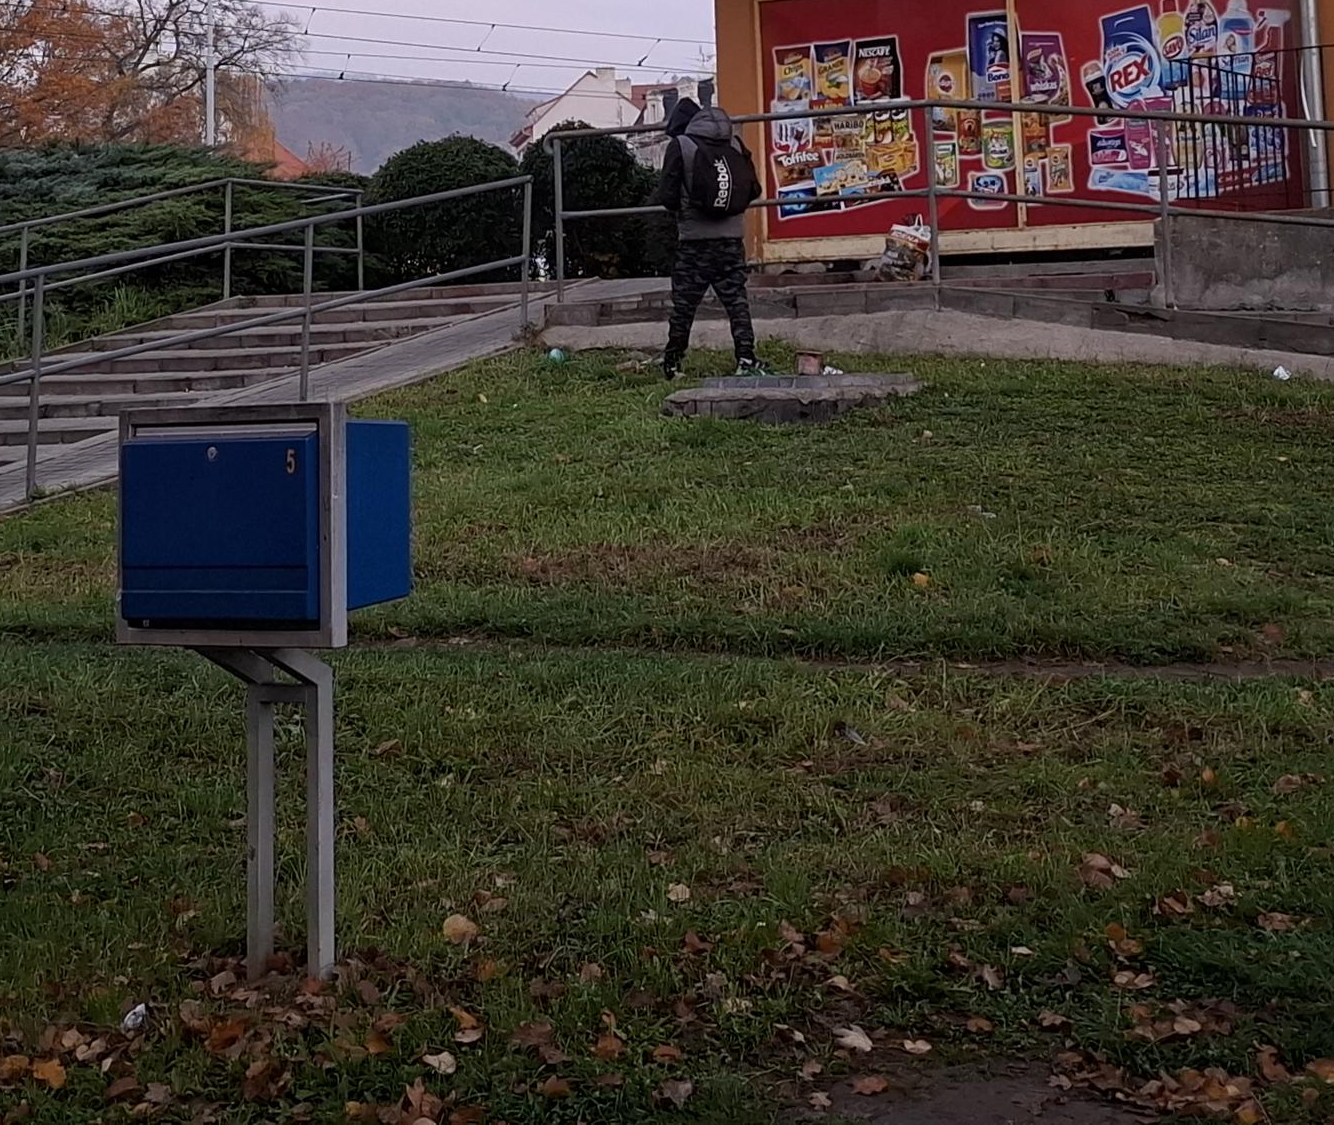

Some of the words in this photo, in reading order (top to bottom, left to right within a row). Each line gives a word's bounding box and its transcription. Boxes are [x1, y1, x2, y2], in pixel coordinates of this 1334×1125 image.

[1188, 25, 1216, 43] Silan
[1110, 54, 1150, 92] REX
[834, 120, 864, 130] HARIBO
[777, 151, 820, 168] Toffifee
[713, 159, 729, 207] Reebok
[285, 448, 296, 474] 5
